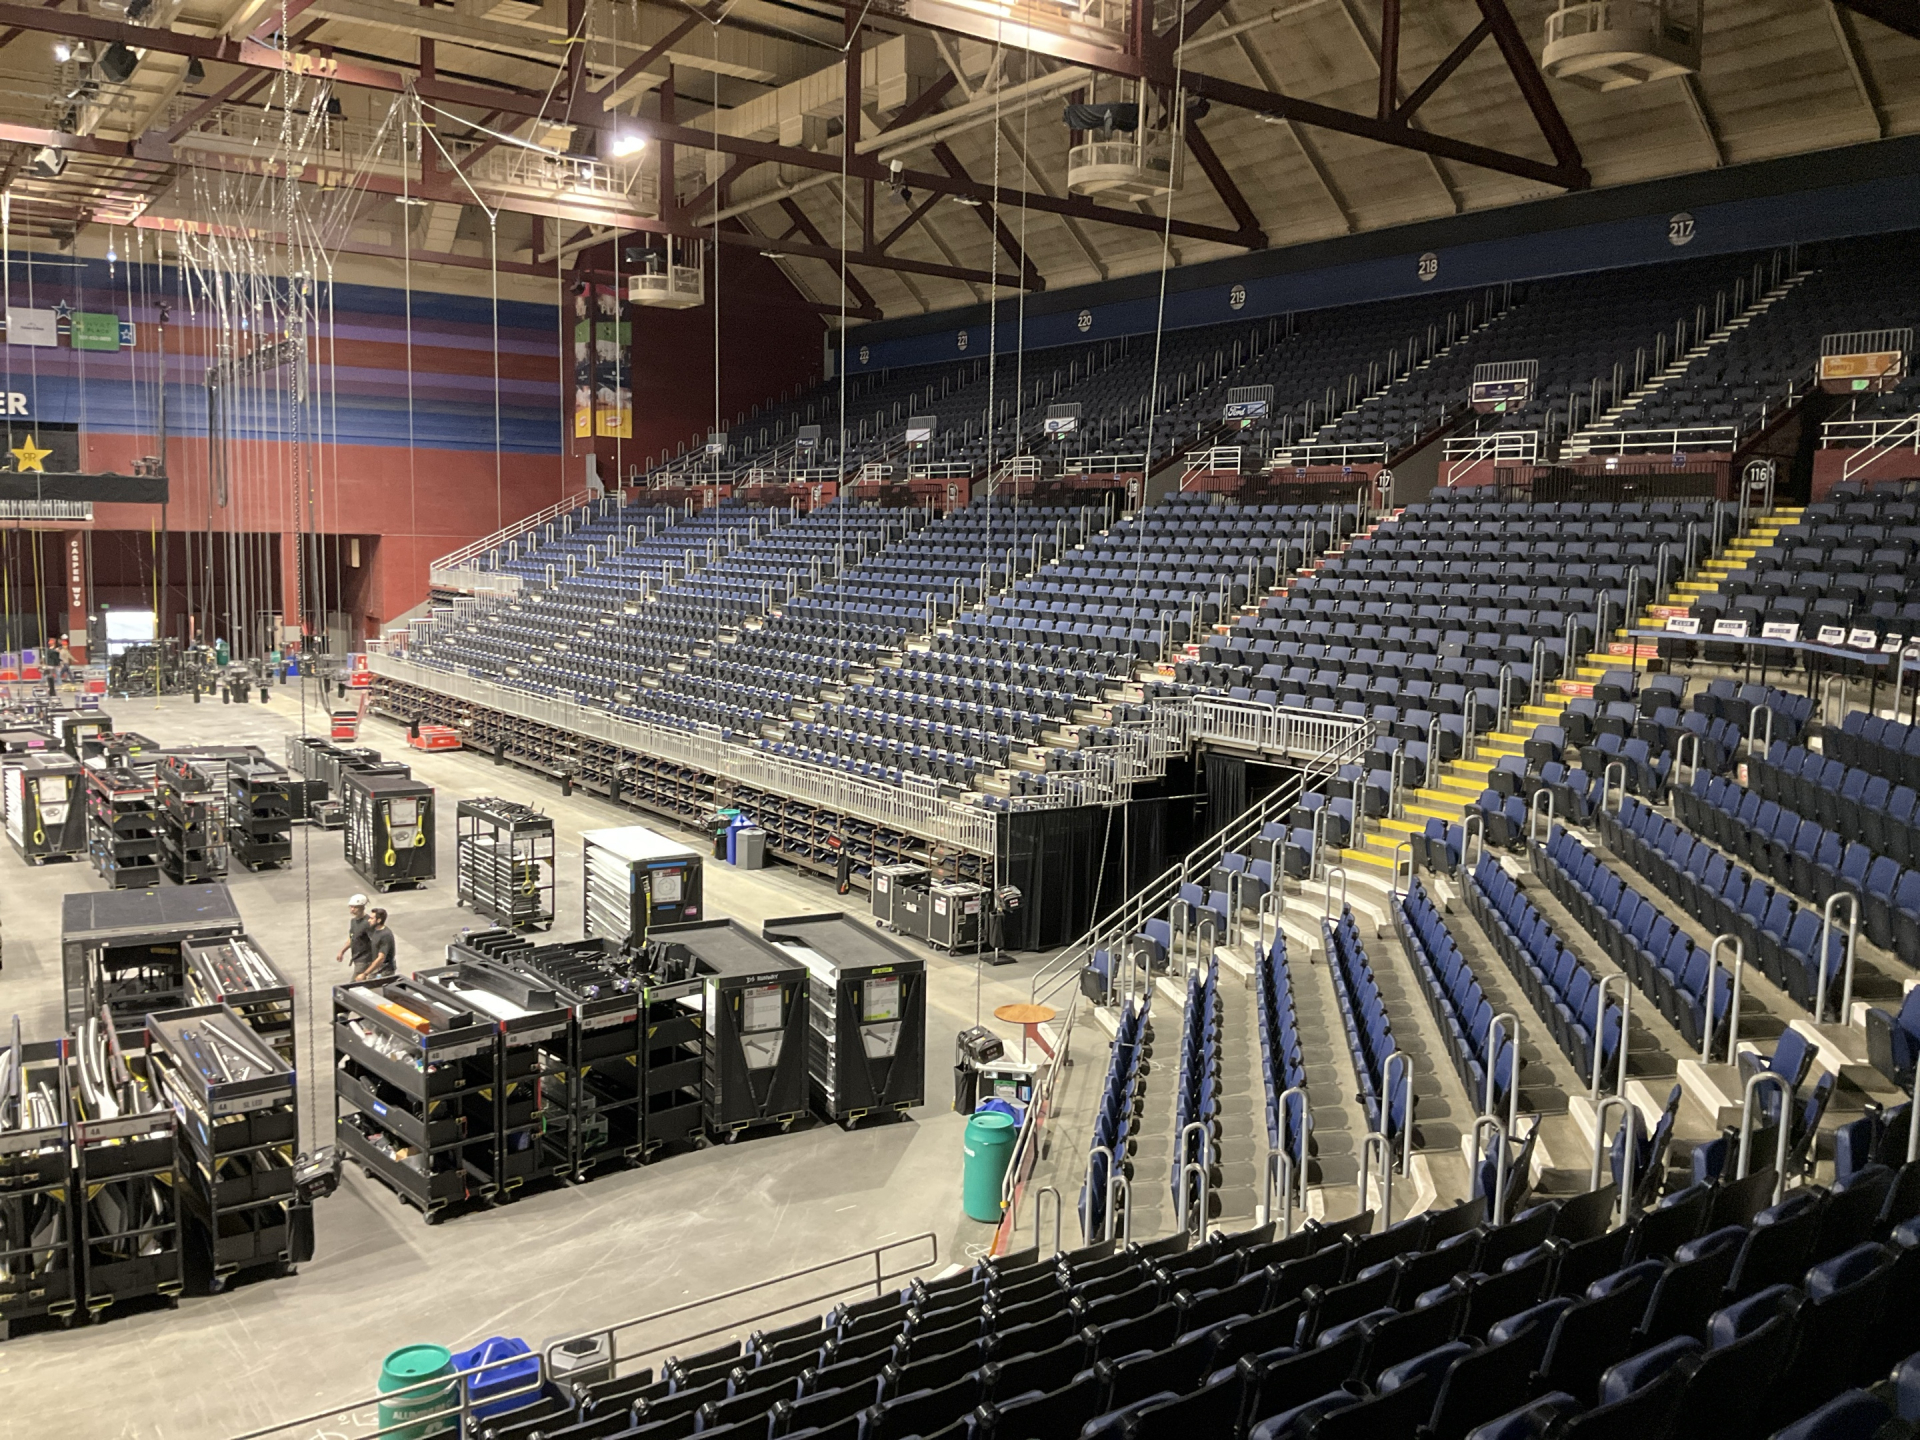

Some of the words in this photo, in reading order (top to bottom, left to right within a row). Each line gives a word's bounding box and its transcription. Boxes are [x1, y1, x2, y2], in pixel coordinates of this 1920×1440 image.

[1669, 220, 1694, 237] 217
[1418, 259, 1438, 274] 218
[1230, 291, 1245, 304] 219
[1078, 315, 1092, 327] 220
[957, 335, 968, 345] 221
[859, 350, 869, 359] 222
[1228, 405, 1246, 417] Ford
[1750, 467, 1767, 482] 116
[71, 540, 80, 582] CASPER
[72, 587, 81, 607] WYO
[218, 1103, 228, 1111] 4A
